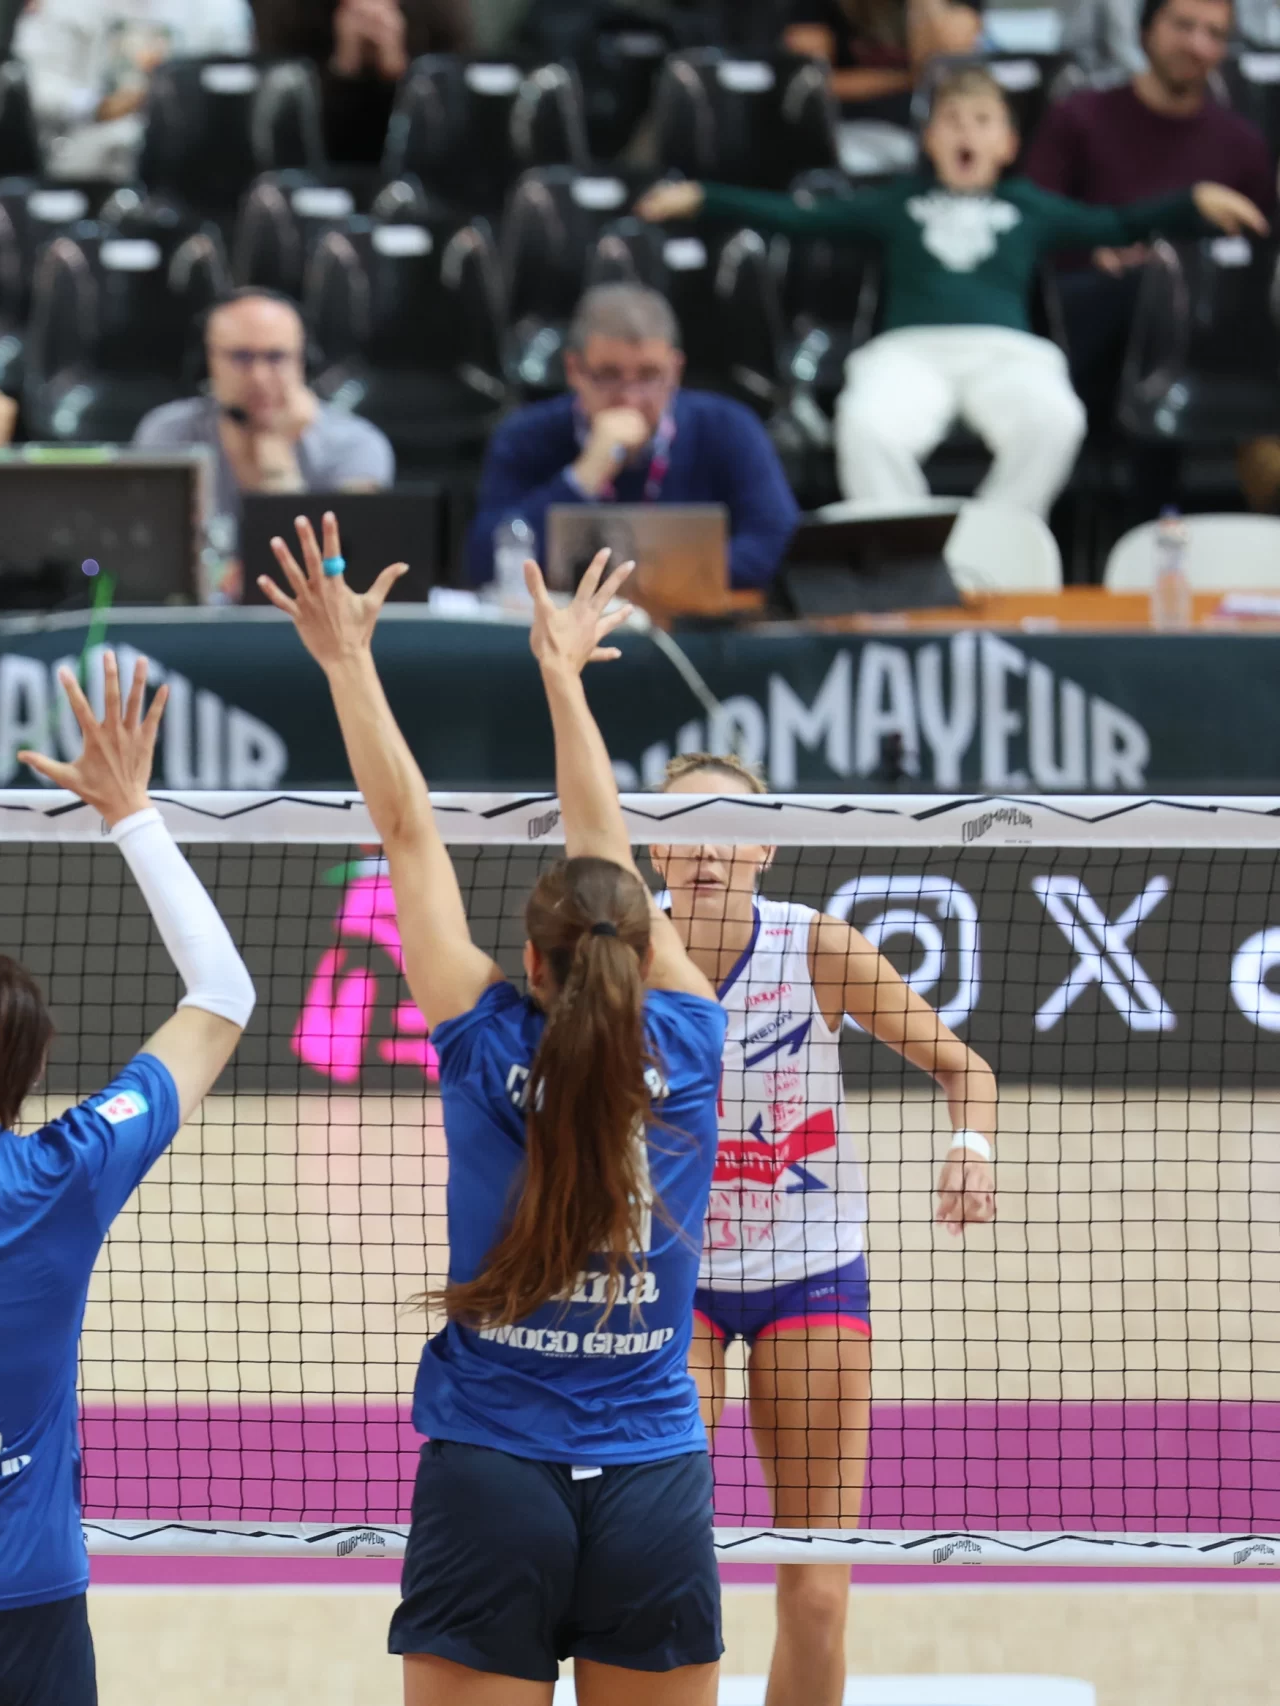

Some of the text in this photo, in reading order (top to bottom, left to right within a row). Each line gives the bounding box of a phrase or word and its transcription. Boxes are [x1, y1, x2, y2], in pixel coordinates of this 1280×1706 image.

[583, 1327, 674, 1355] GROUP
[337, 1532, 386, 1556] COURMAYEUR
[933, 1540, 982, 1564] COURMAYEUR
